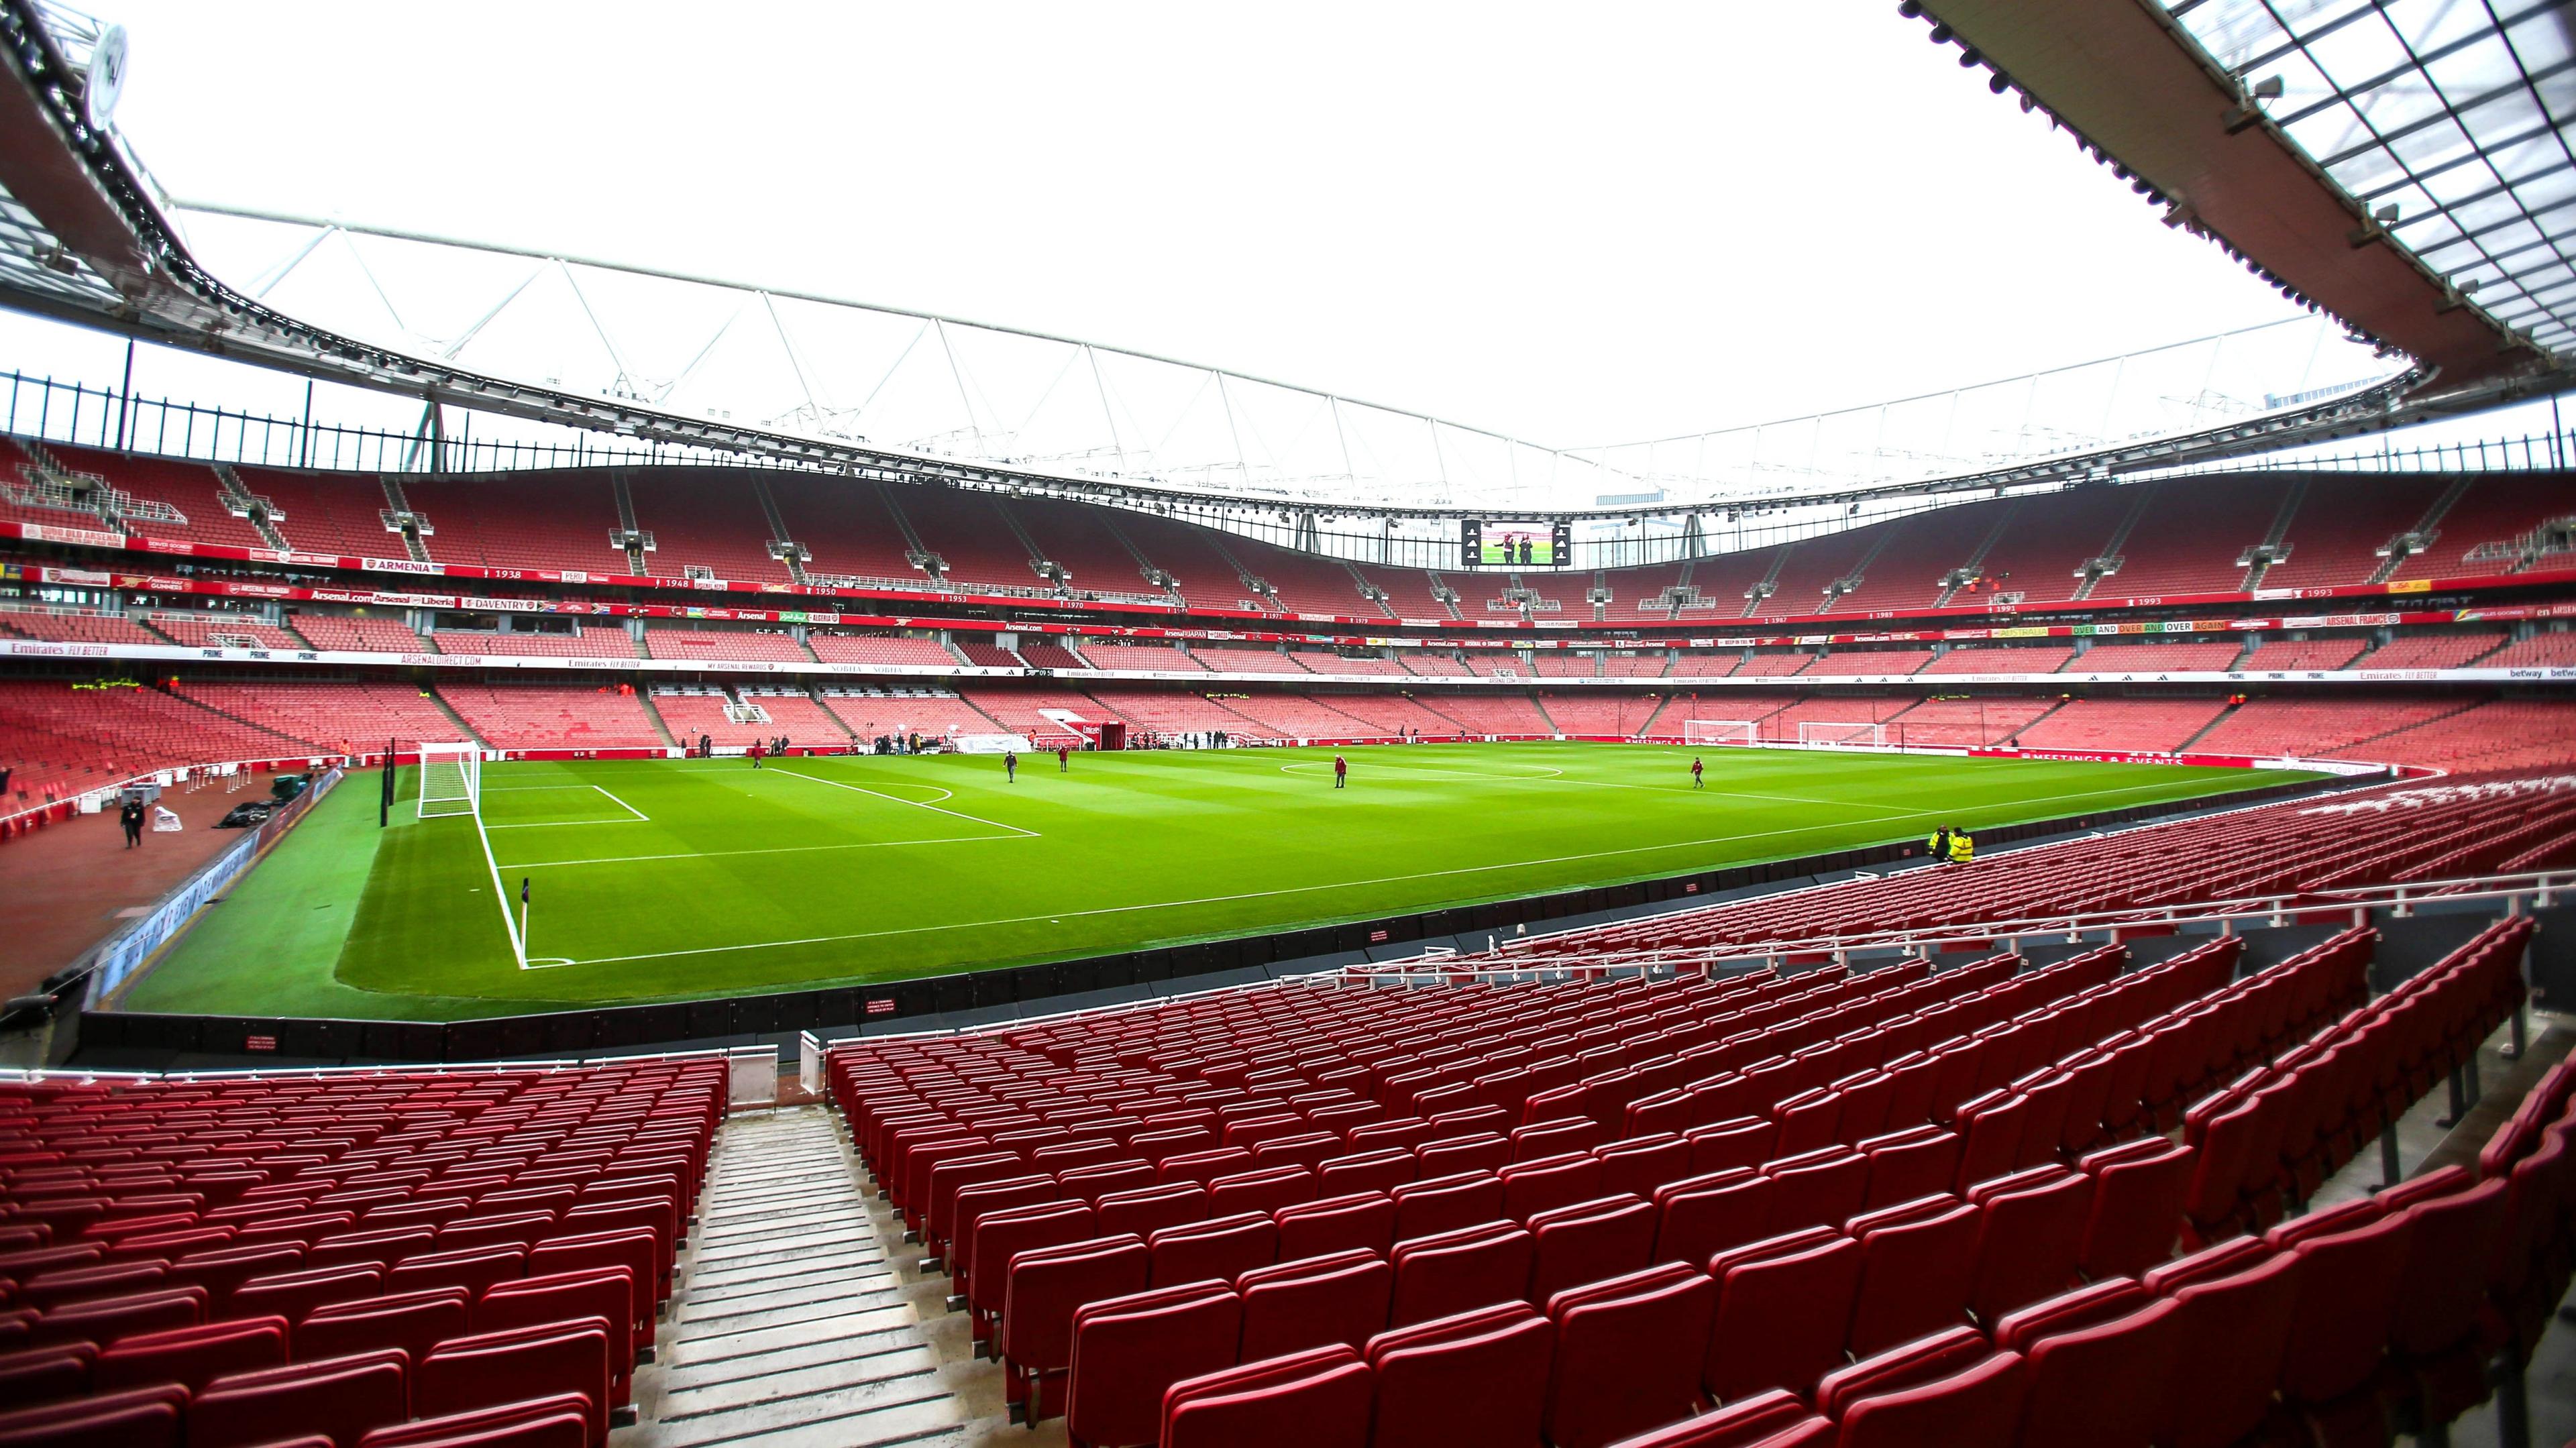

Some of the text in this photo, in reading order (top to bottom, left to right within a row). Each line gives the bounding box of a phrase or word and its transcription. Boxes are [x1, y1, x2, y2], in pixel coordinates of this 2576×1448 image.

[85, 531, 121, 542] ARSENAL
[378, 561, 430, 573] ARMENIA
[495, 570, 521, 579] 1938
[566, 572, 583, 580] PERU
[816, 588, 837, 596] 1950
[2308, 589, 2332, 597] 1993
[311, 590, 374, 604] Arsenal.com
[374, 594, 454, 606] Arsenal Liberia
[475, 600, 525, 610] DAVENTRY
[737, 611, 766, 621] Arsenal
[813, 614, 831, 622] ALGERIA
[2326, 616, 2358, 626] ARSENAL
[2359, 614, 2388, 624] FRANCE
[1005, 623, 1042, 632] Arsenal.com
[2000, 628, 2047, 636] AUSTRALIA
[2073, 624, 2094, 634] OVER
[2098, 624, 2116, 633] AND
[2118, 624, 2142, 632] OVER
[2145, 622, 2164, 632] AND
[2166, 622, 2191, 631] OVER
[2194, 621, 2225, 630] AGAIN
[11, 643, 109, 656] Emirates FLY BETTER
[203, 649, 223, 658] PRIME
[250, 651, 270, 659] PRIME
[297, 652, 318, 661] PRIME
[400, 653, 482, 666] ARSENALDIRECT.COM
[568, 659, 641, 669] Emirates FLY BETTER
[2360, 671, 2438, 680] Emirates FLY BETTER
[2510, 670, 2542, 679] betway
[2033, 753, 2102, 763] MEETINGS
[2127, 757, 2184, 766] EVENTS
